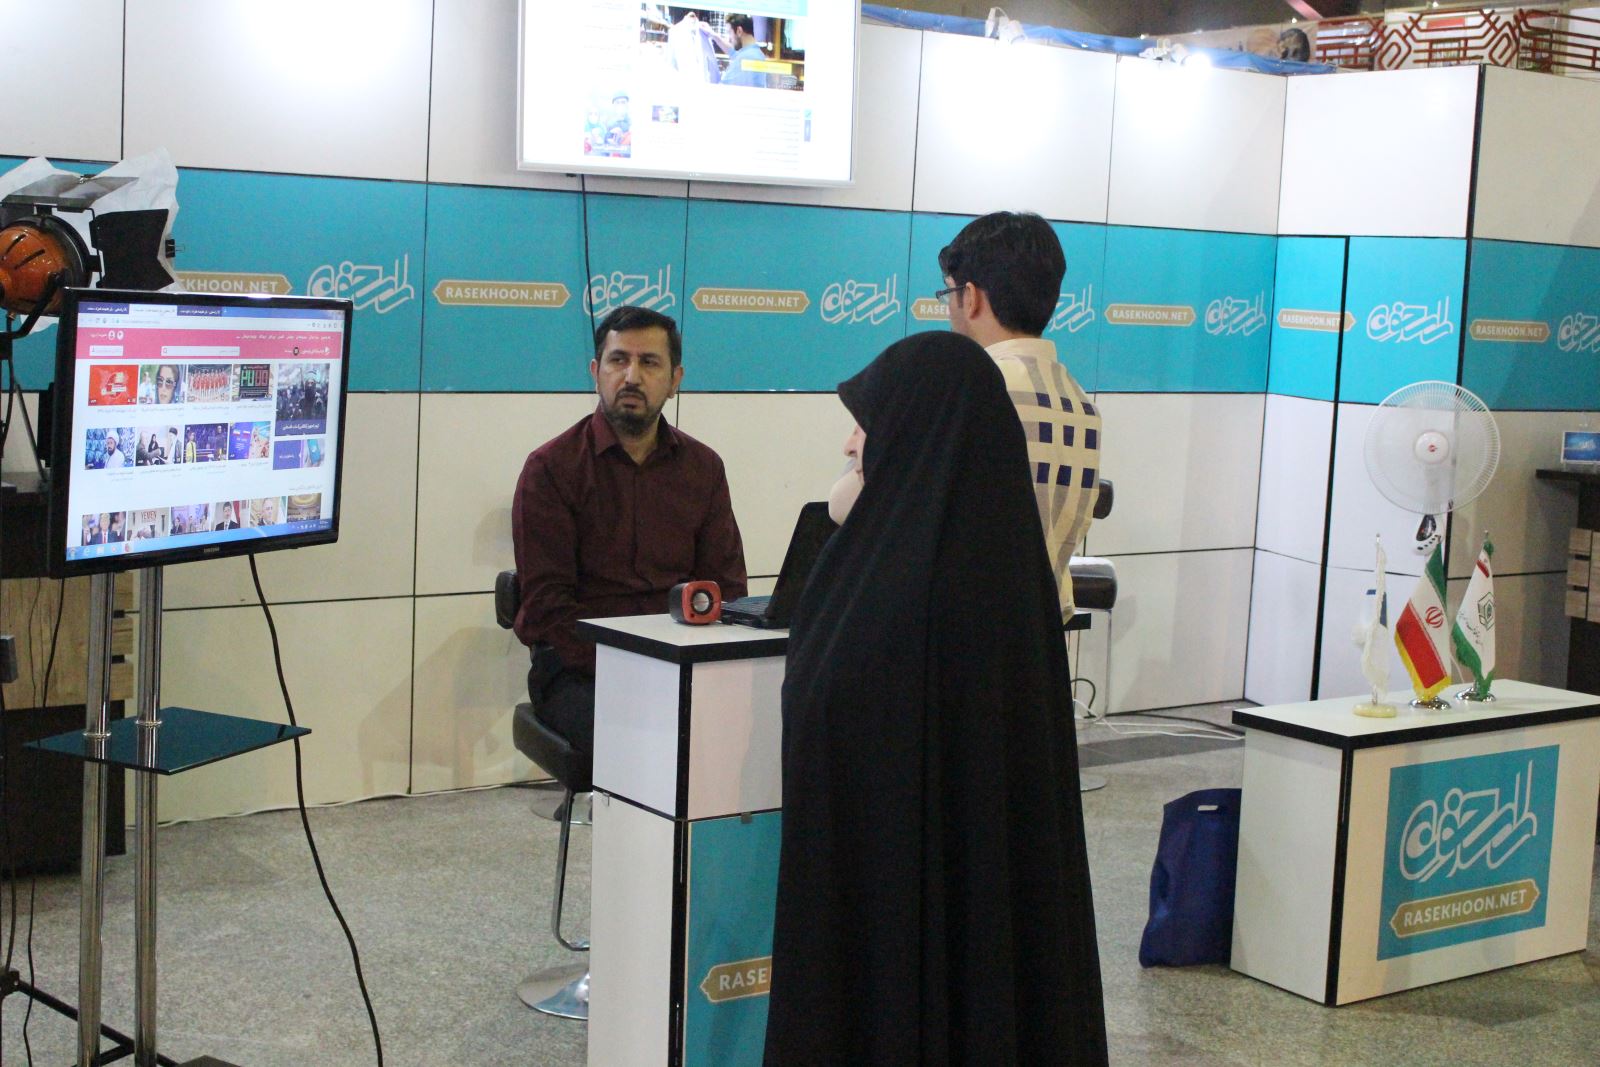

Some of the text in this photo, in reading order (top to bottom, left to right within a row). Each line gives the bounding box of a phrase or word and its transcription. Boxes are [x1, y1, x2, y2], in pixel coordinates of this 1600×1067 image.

[178, 279, 278, 293] EKHOON.NET
[445, 287, 560, 301] RASEKHOON.NET
[702, 294, 800, 307] RASEKHOON.NET
[920, 303, 950, 316] RASE
[1112, 310, 1188, 322] RASEKHOON.NET
[1476, 324, 1543, 337] RASEKHOON.NET
[1403, 889, 1528, 928] RASEKHOON.NET
[719, 967, 769, 992] RASE
